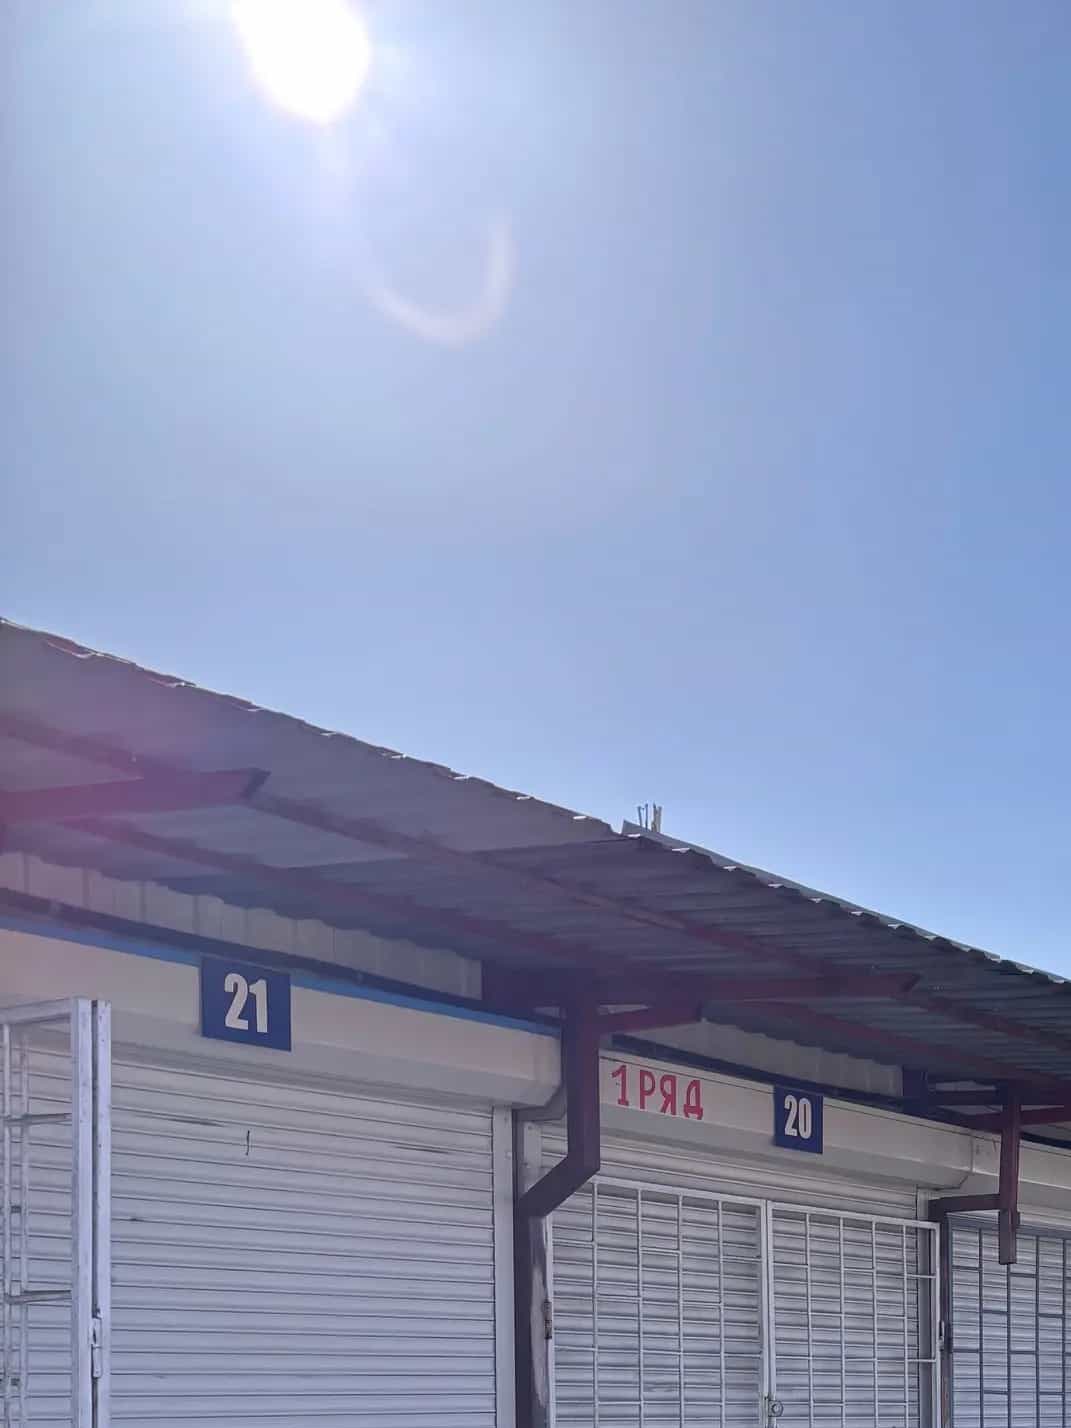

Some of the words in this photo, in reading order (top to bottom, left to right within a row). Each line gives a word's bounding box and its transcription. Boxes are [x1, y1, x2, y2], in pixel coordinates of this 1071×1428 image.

[224, 973, 268, 1033] 21
[611, 1064, 629, 1107] 1
[639, 1069, 704, 1120] РЯД
[784, 1095, 812, 1139] 20
